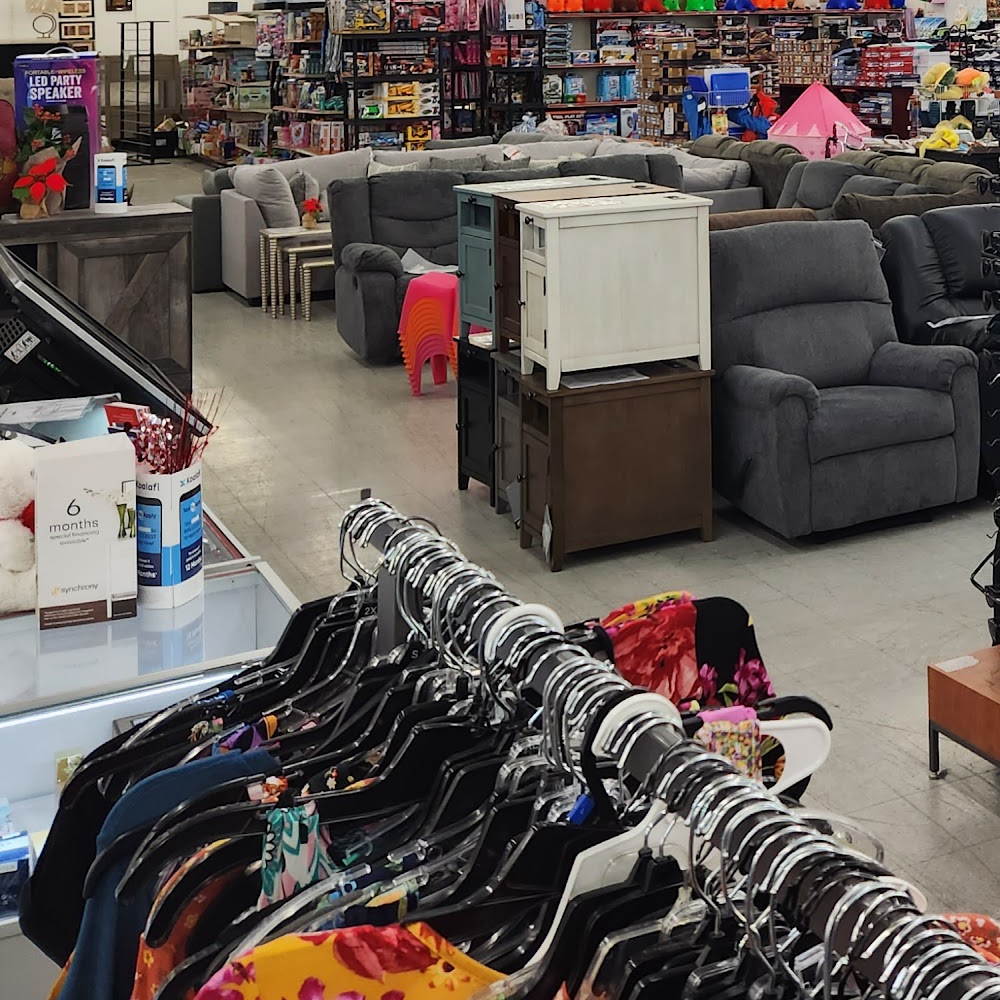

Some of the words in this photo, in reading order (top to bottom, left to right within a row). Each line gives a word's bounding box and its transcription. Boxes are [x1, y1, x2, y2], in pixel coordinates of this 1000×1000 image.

[29, 76, 48, 87] LED
[50, 75, 82, 86] PARTY
[29, 87, 82, 100] SPEAKER
[66, 498, 81, 517] 6
[49, 518, 99, 533] months
[60, 583, 99, 594] synchrony
[411, 650, 419, 659] S
